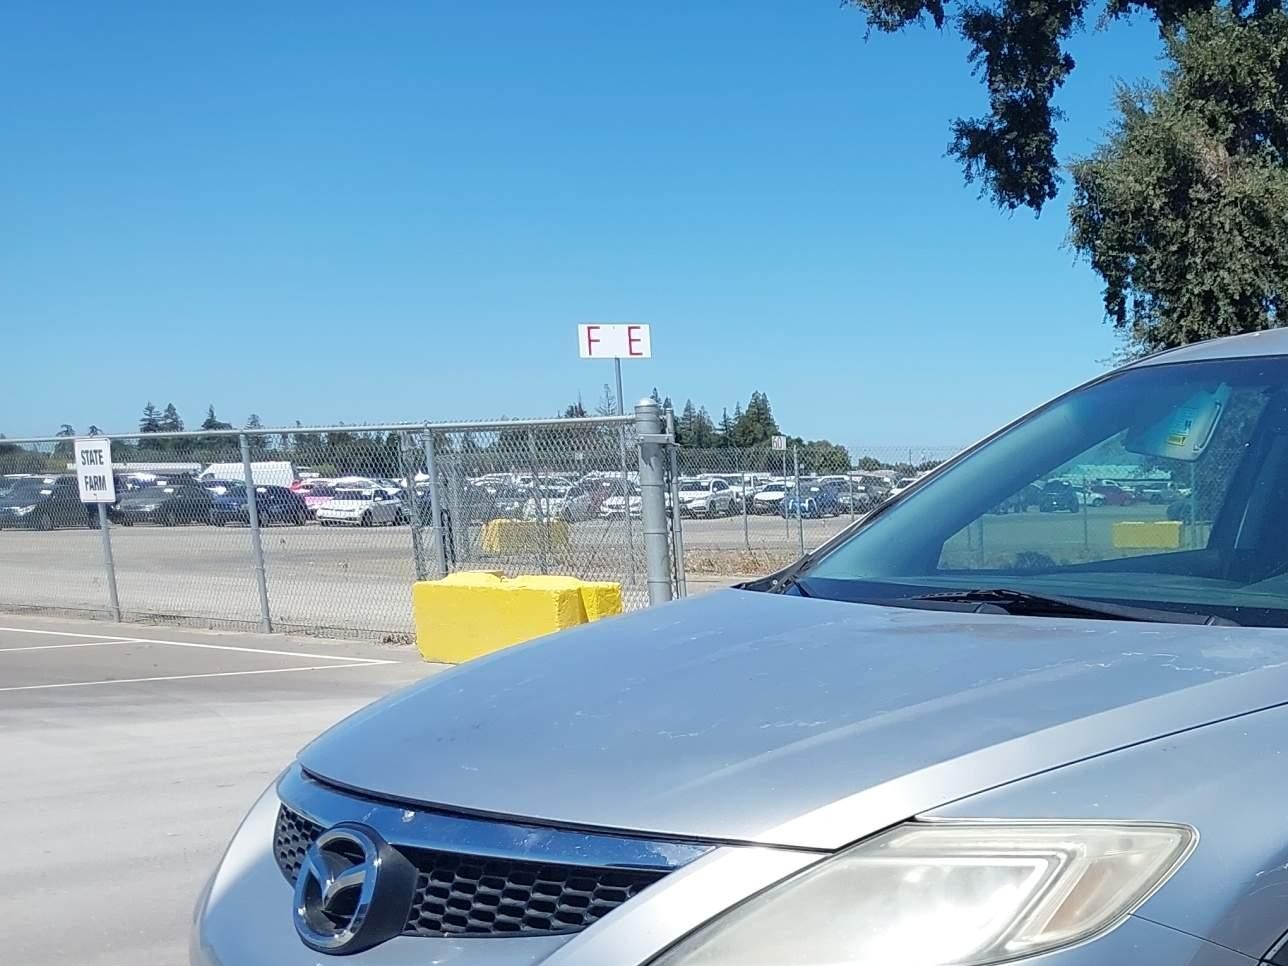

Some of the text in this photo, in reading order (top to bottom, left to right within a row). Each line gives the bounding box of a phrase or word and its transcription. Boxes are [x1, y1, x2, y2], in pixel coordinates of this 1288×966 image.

[587, 326, 643, 355] F E
[81, 449, 104, 465] STATE
[84, 475, 107, 491] FARM
